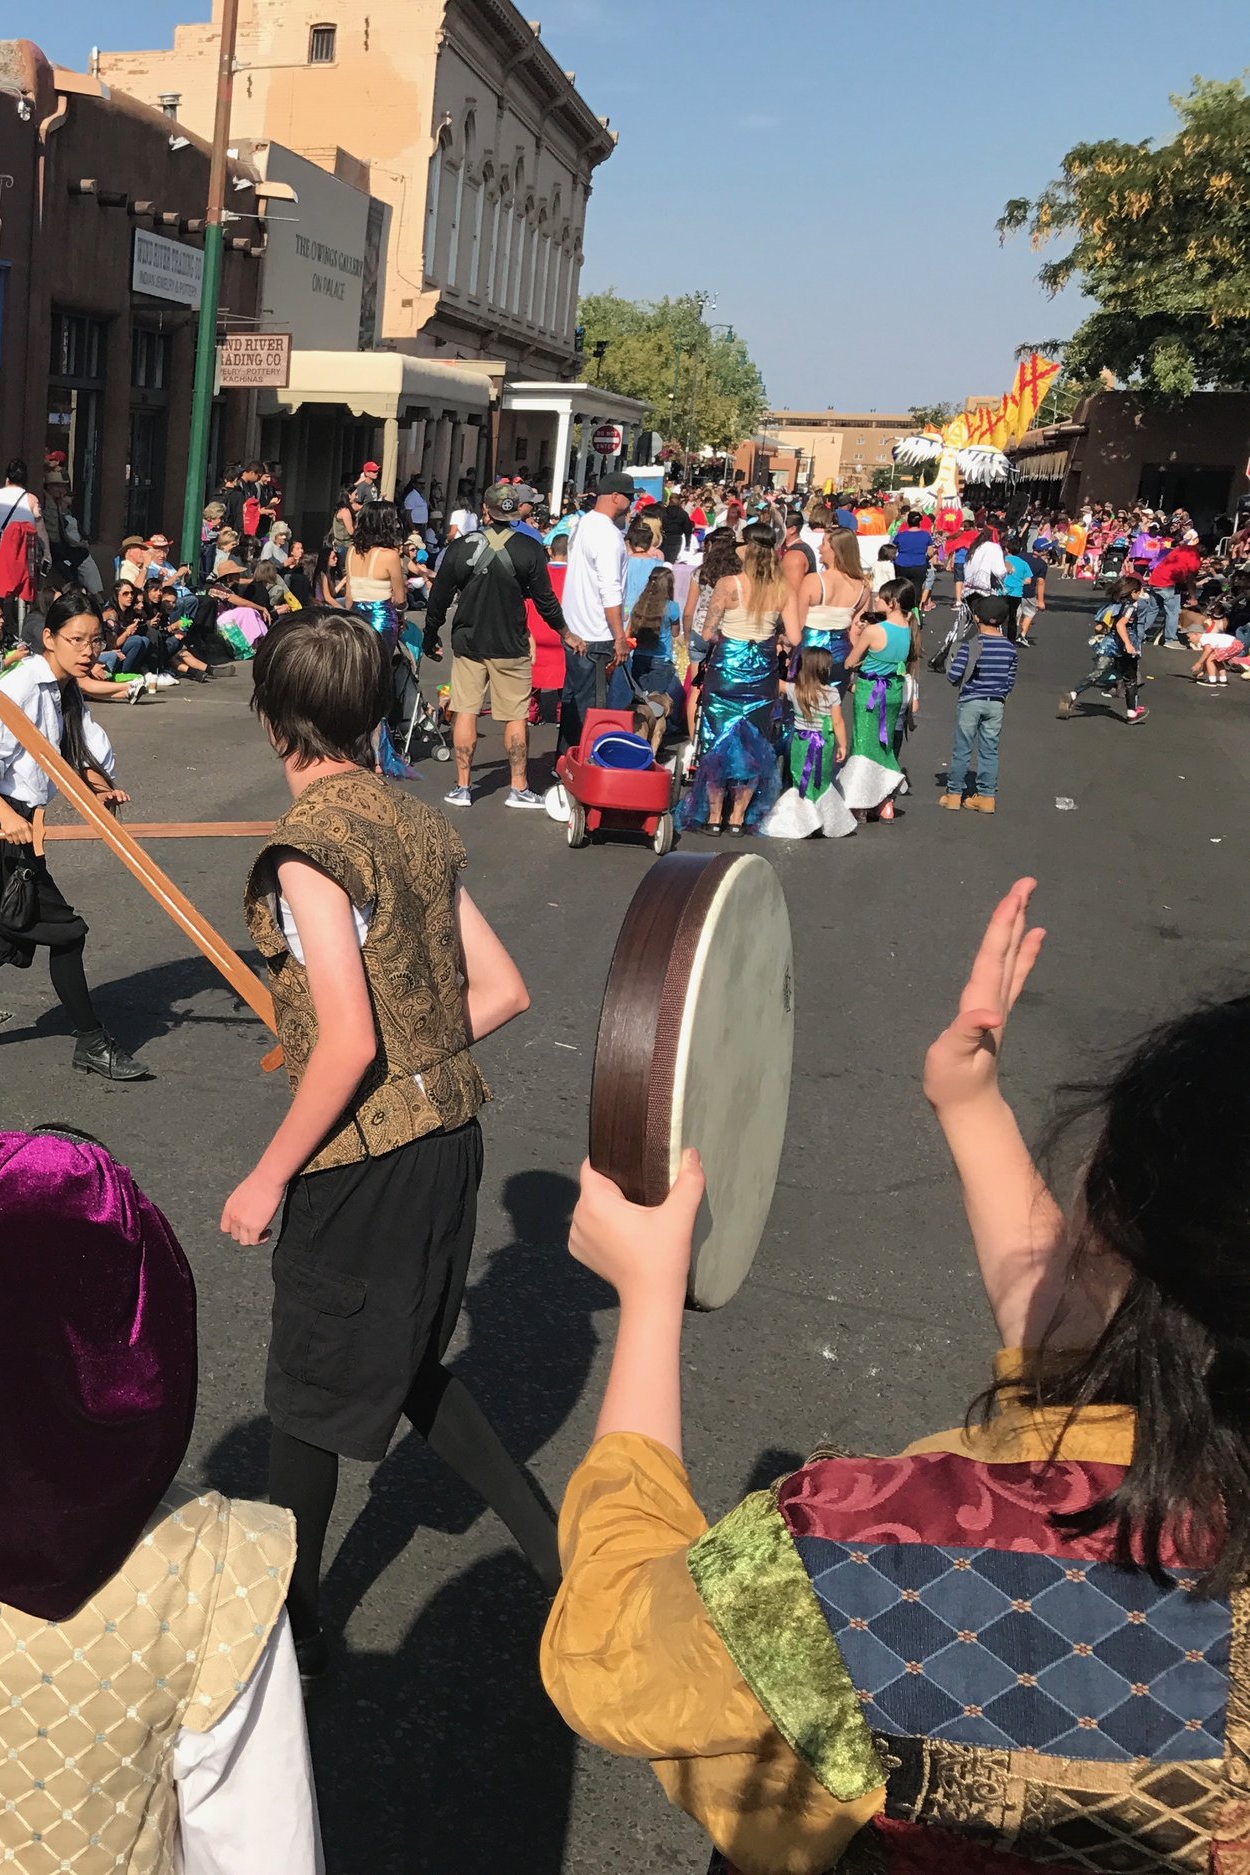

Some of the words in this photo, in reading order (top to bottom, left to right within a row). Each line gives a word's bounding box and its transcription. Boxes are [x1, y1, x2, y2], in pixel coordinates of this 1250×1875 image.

[295, 233, 310, 258] THE
[311, 241, 337, 267] OWINGS
[338, 252, 363, 278] GALLERY
[312, 273, 322, 293] ON
[323, 277, 346, 301] PALACE
[217, 339, 242, 351] IND
[245, 338, 283, 352] RIVER
[222, 353, 262, 366] ADING
[266, 353, 281, 366] CO
